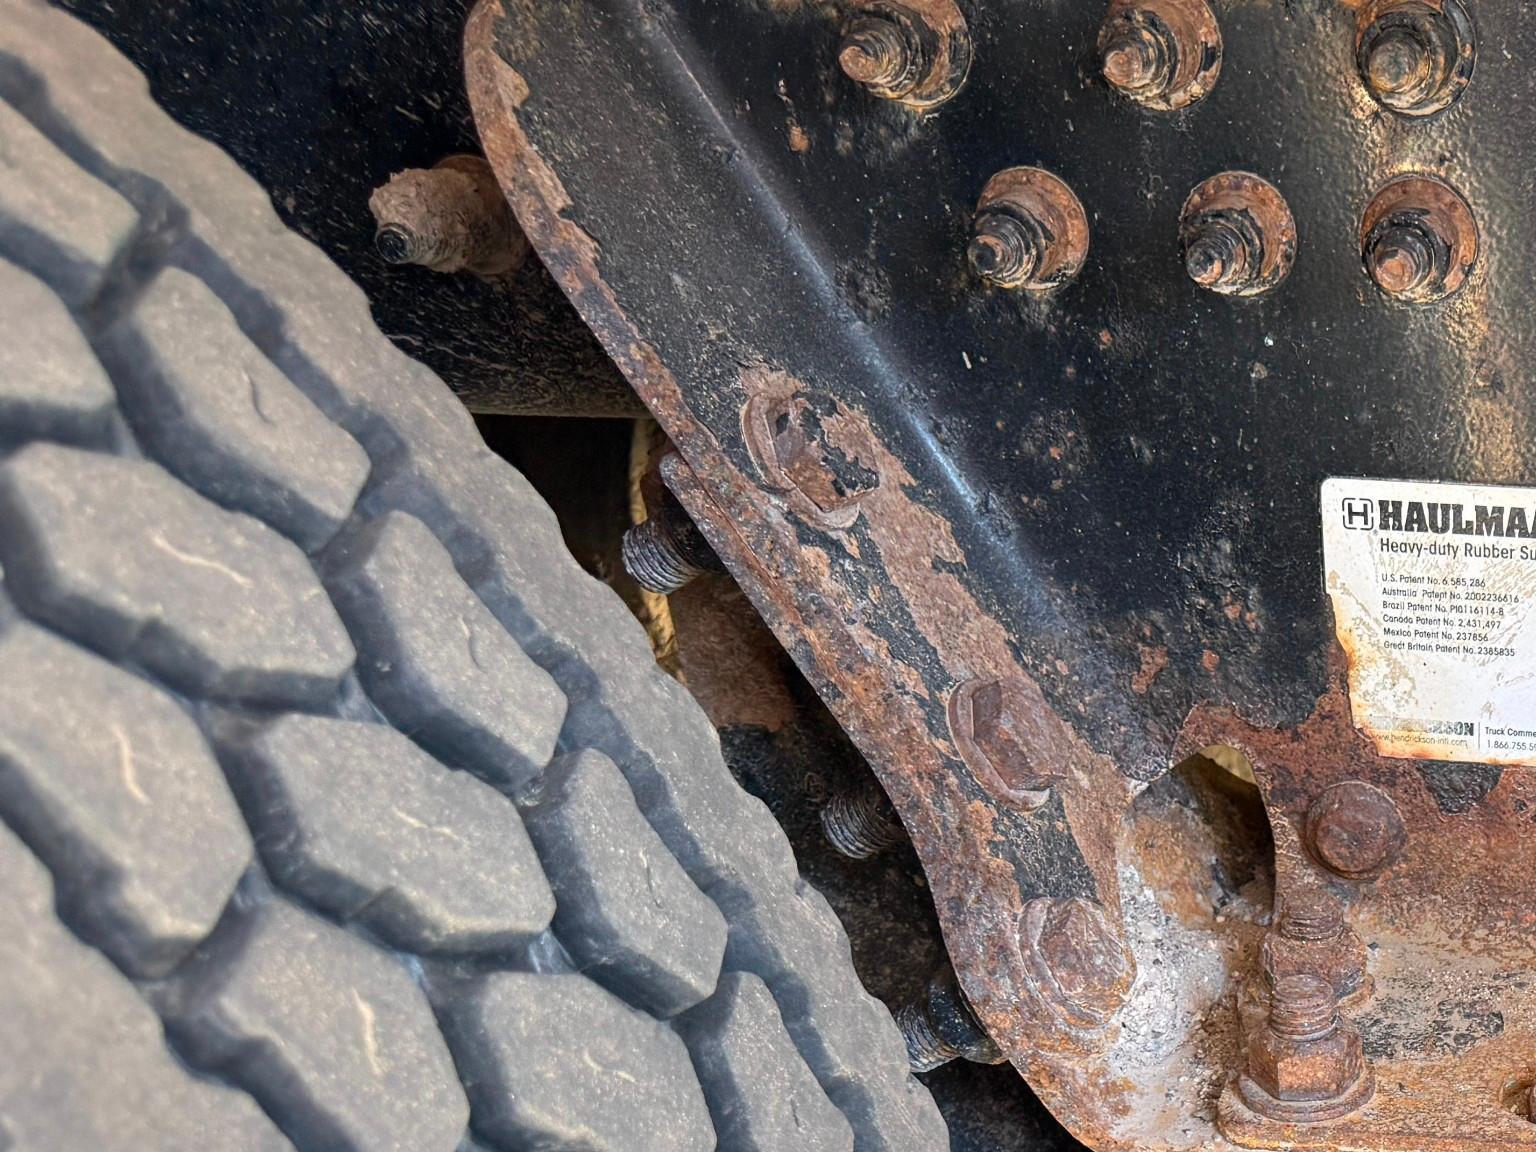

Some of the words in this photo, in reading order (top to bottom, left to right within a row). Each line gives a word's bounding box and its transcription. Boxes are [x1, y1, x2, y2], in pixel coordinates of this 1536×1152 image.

[1380, 538, 1459, 559] Heavy-duty
[1464, 543, 1516, 559] Rubber
[1382, 573, 1398, 583] U.S.
[1400, 575, 1425, 584] Patent
[1427, 576, 1440, 585] No.
[1382, 587, 1417, 598] Australia
[1422, 590, 1448, 600] Patent
[1450, 591, 1463, 601] No.
[1383, 600, 1405, 610] Brazil
[1407, 602, 1433, 612] Patent
[1435, 604, 1448, 613] No.
[1383, 614, 1413, 624] Canada
[1416, 615, 1441, 626] Patent
[1443, 617, 1456, 627] No.
[1458, 619, 1501, 630] 2,431,497
[1383, 628, 1412, 638] Mexico
[1414, 629, 1439, 640] Patent
[1442, 631, 1454, 640] No.
[1456, 632, 1489, 642] 237856
[1384, 641, 1405, 650] Great
[1408, 642, 1434, 653] Britain
[1436, 644, 1460, 654] Patent
[1463, 646, 1476, 655] No.
[1477, 647, 1516, 657] 2385835
[1485, 726, 1505, 736] Truck
